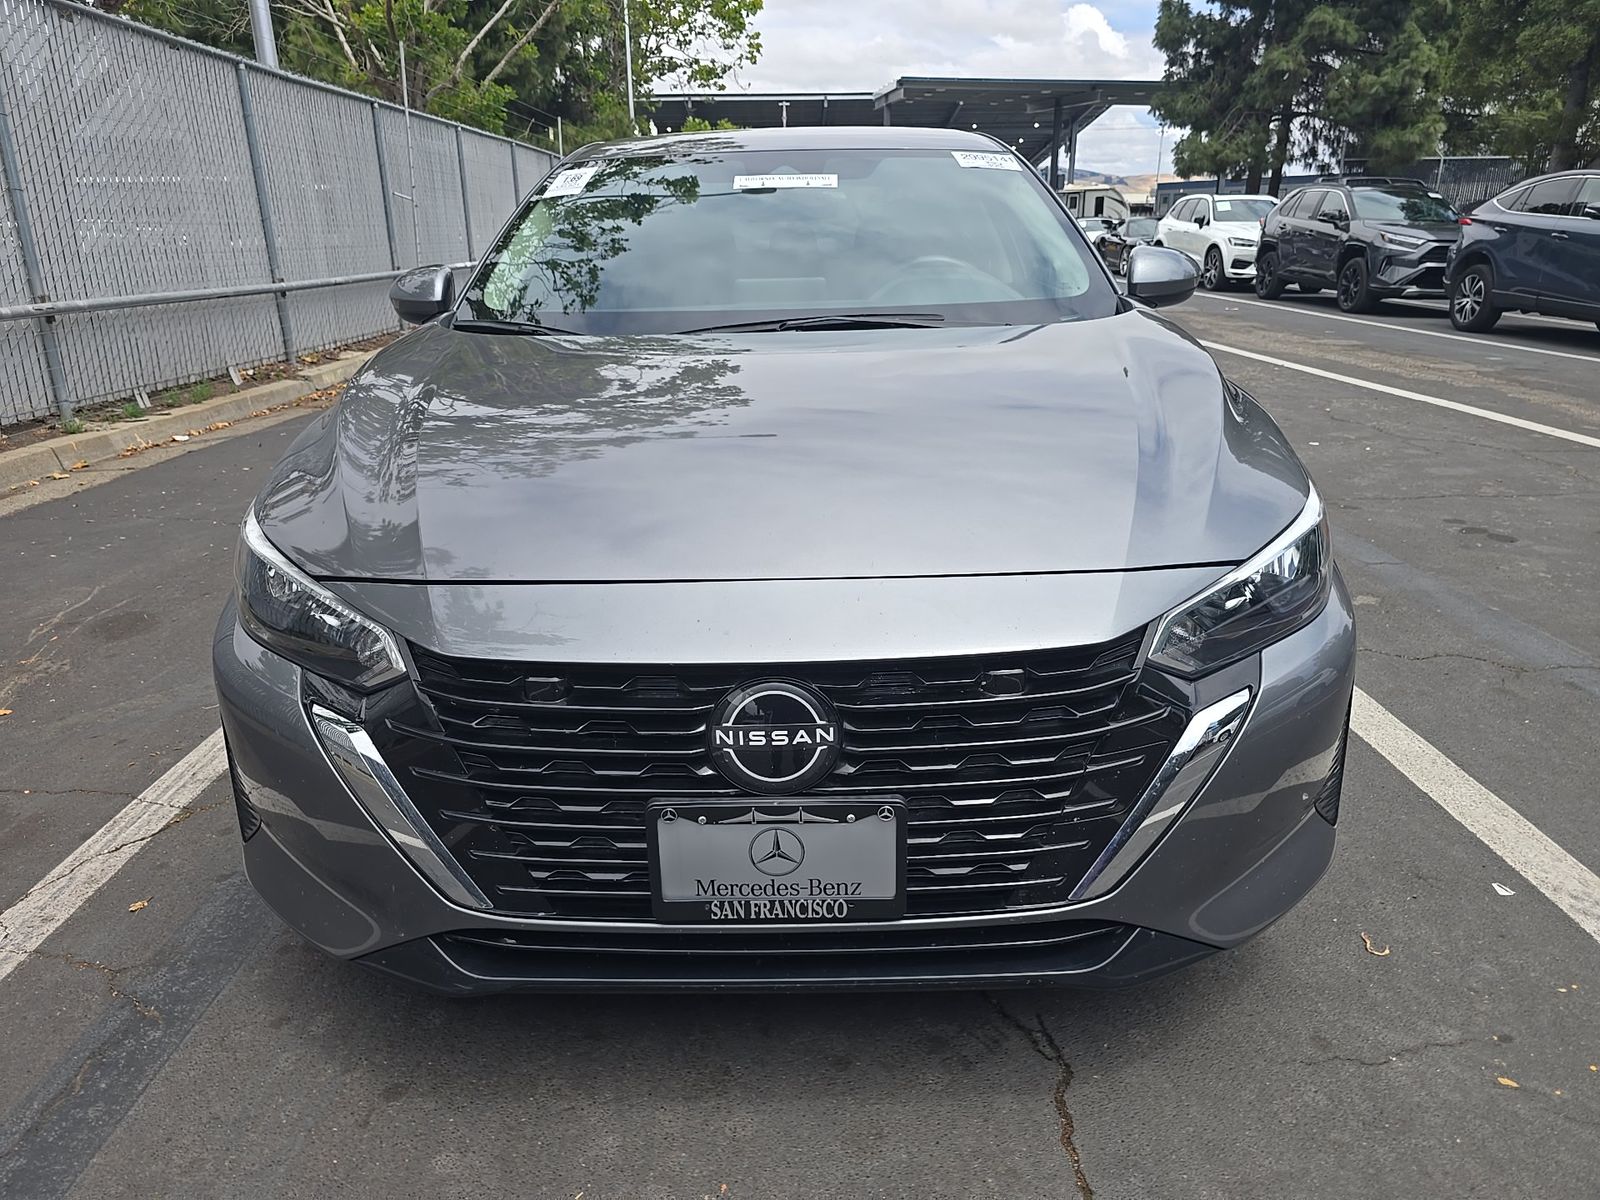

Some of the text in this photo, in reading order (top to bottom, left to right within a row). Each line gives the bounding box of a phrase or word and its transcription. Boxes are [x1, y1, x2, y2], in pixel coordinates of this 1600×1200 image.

[715, 727, 834, 746] NISSAN
[694, 878, 863, 898] Mercedes-Benz
[710, 898, 848, 919] SAN FRANCISCO
